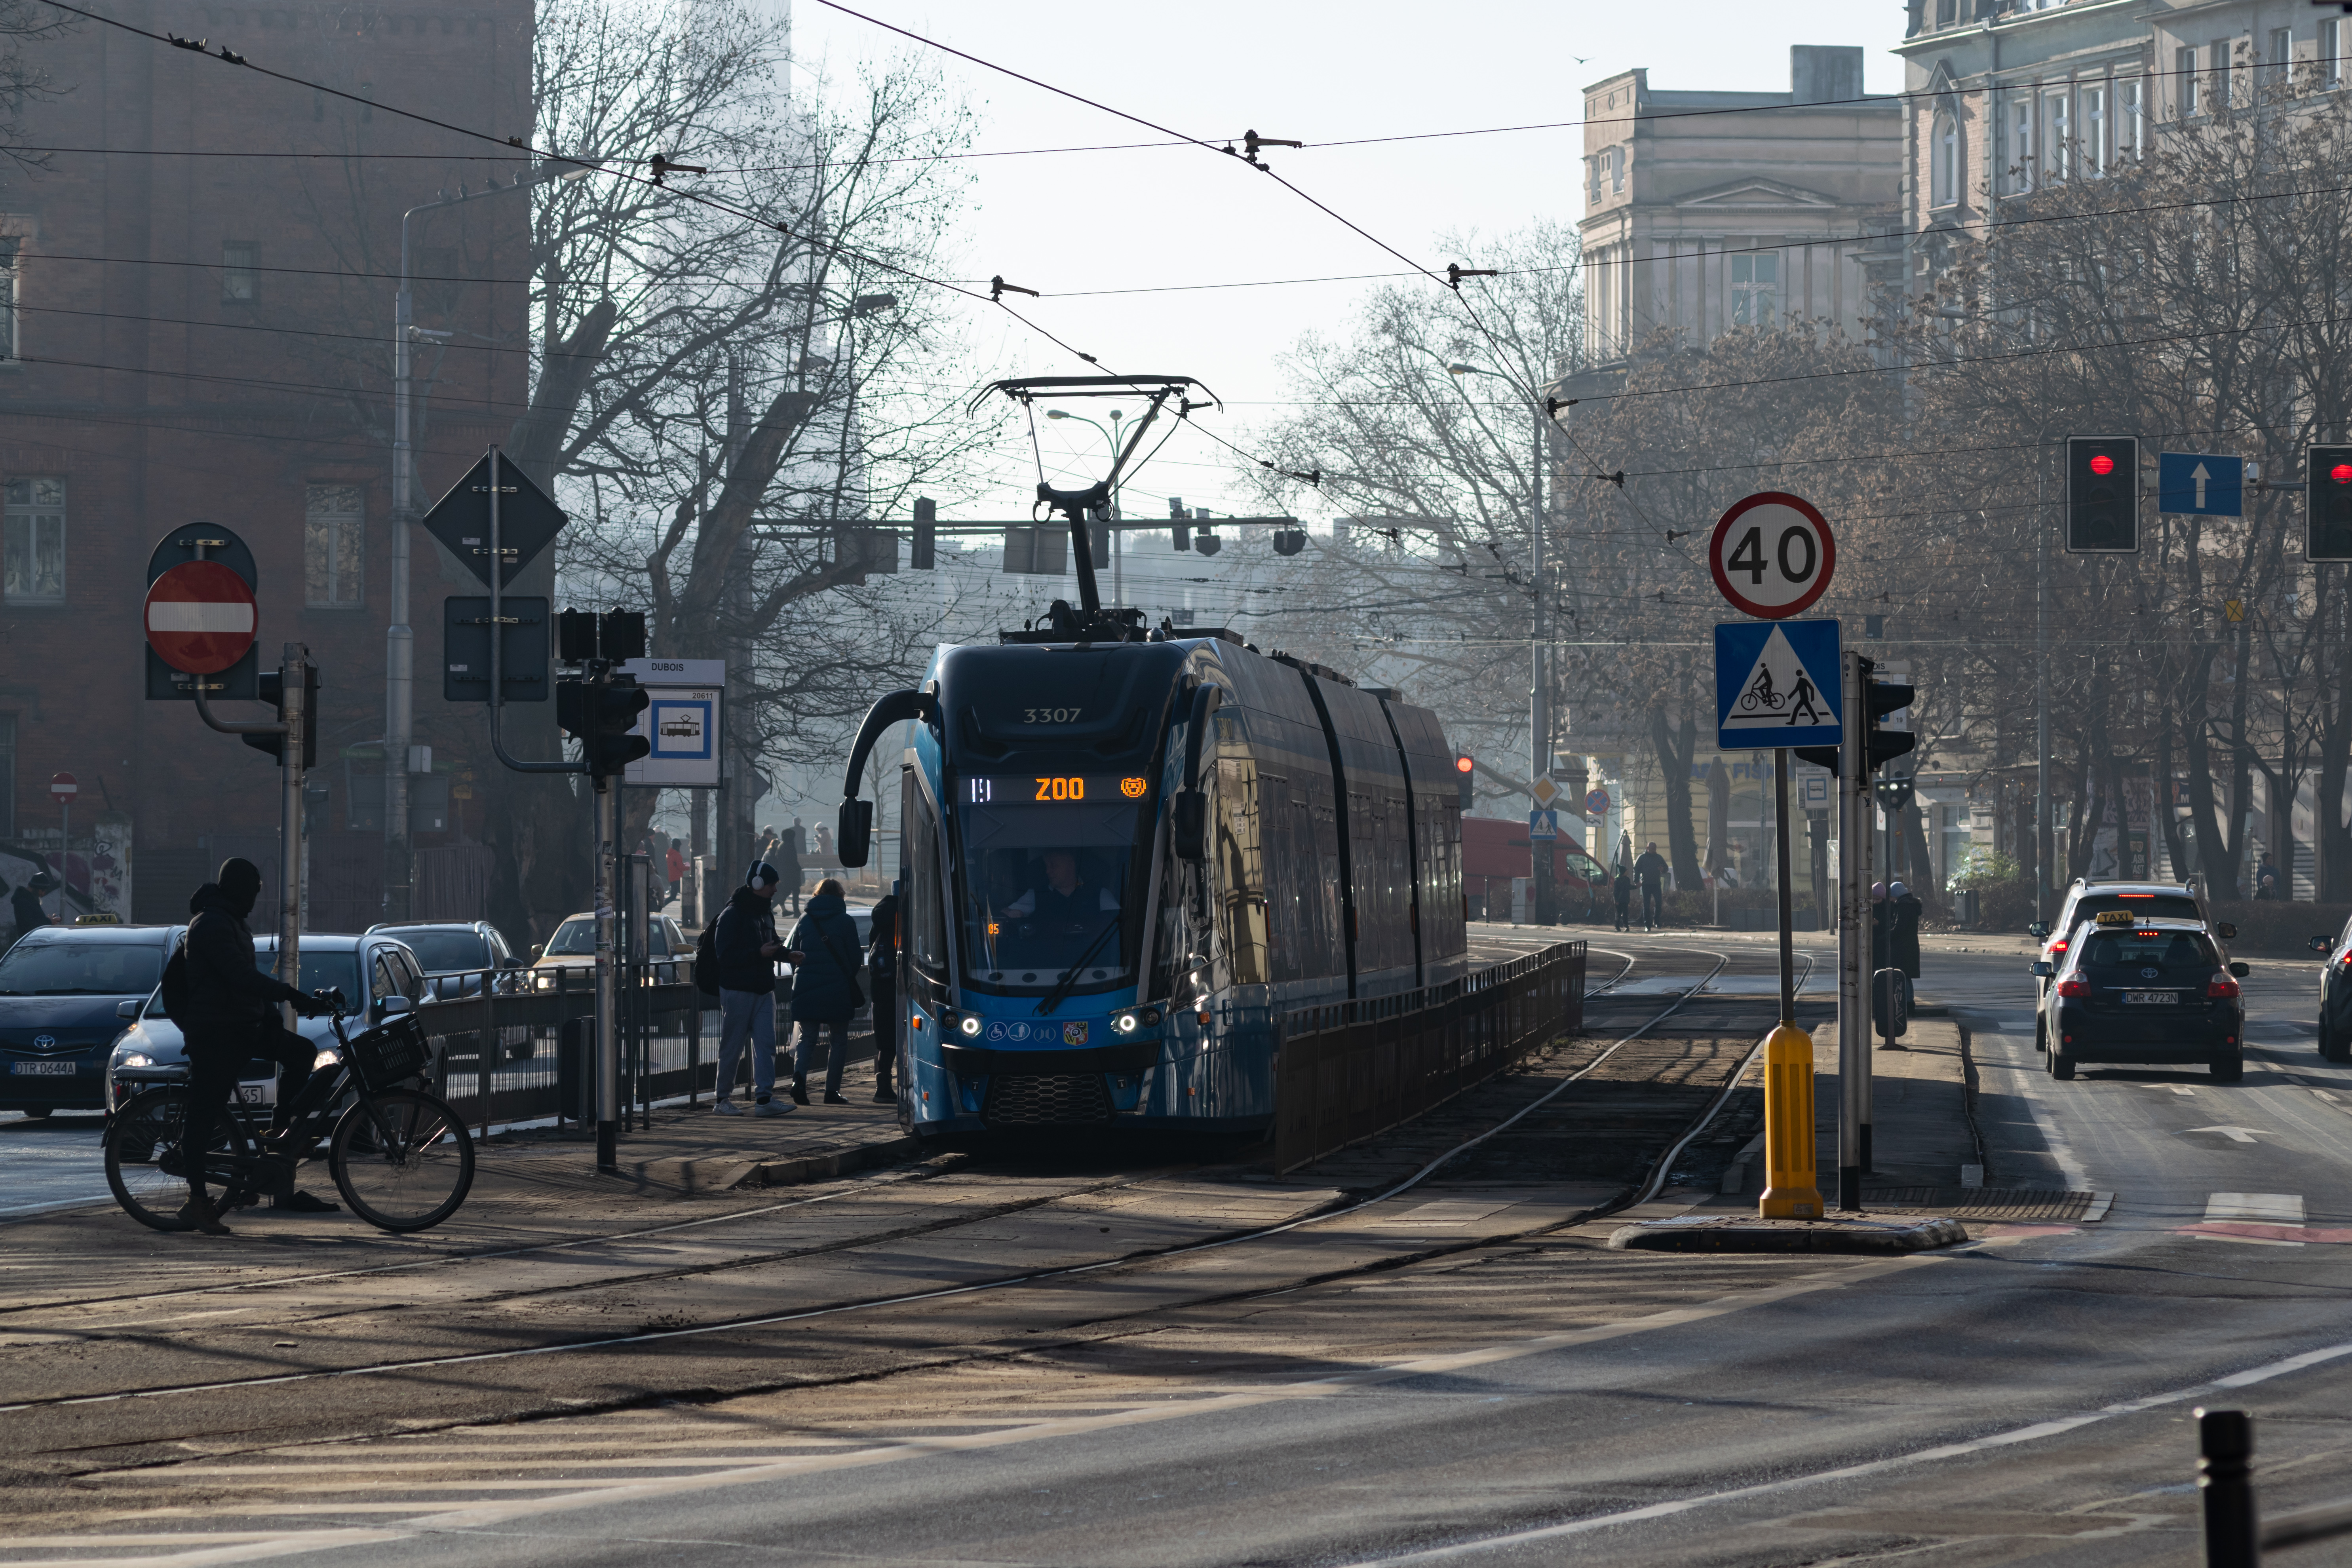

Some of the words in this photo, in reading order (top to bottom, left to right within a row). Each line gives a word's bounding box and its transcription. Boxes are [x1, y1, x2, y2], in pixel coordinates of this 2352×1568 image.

[1728, 526, 1816, 584] 40
[652, 663, 684, 671] DUBOIS
[1023, 708, 1082, 723] 3307
[1216, 717, 1233, 737] 3307
[1035, 777, 1084, 800] ZOO
[2131, 864, 2145, 874] AST
[82, 915, 112, 923] TAXI
[2102, 913, 2128, 922] TAXI
[988, 924, 999, 934] 05
[2126, 993, 2145, 1003] DWR
[2148, 993, 2177, 1003] 4723N
[15, 1063, 36, 1074] DTR
[40, 1063, 74, 1074] 0644A
